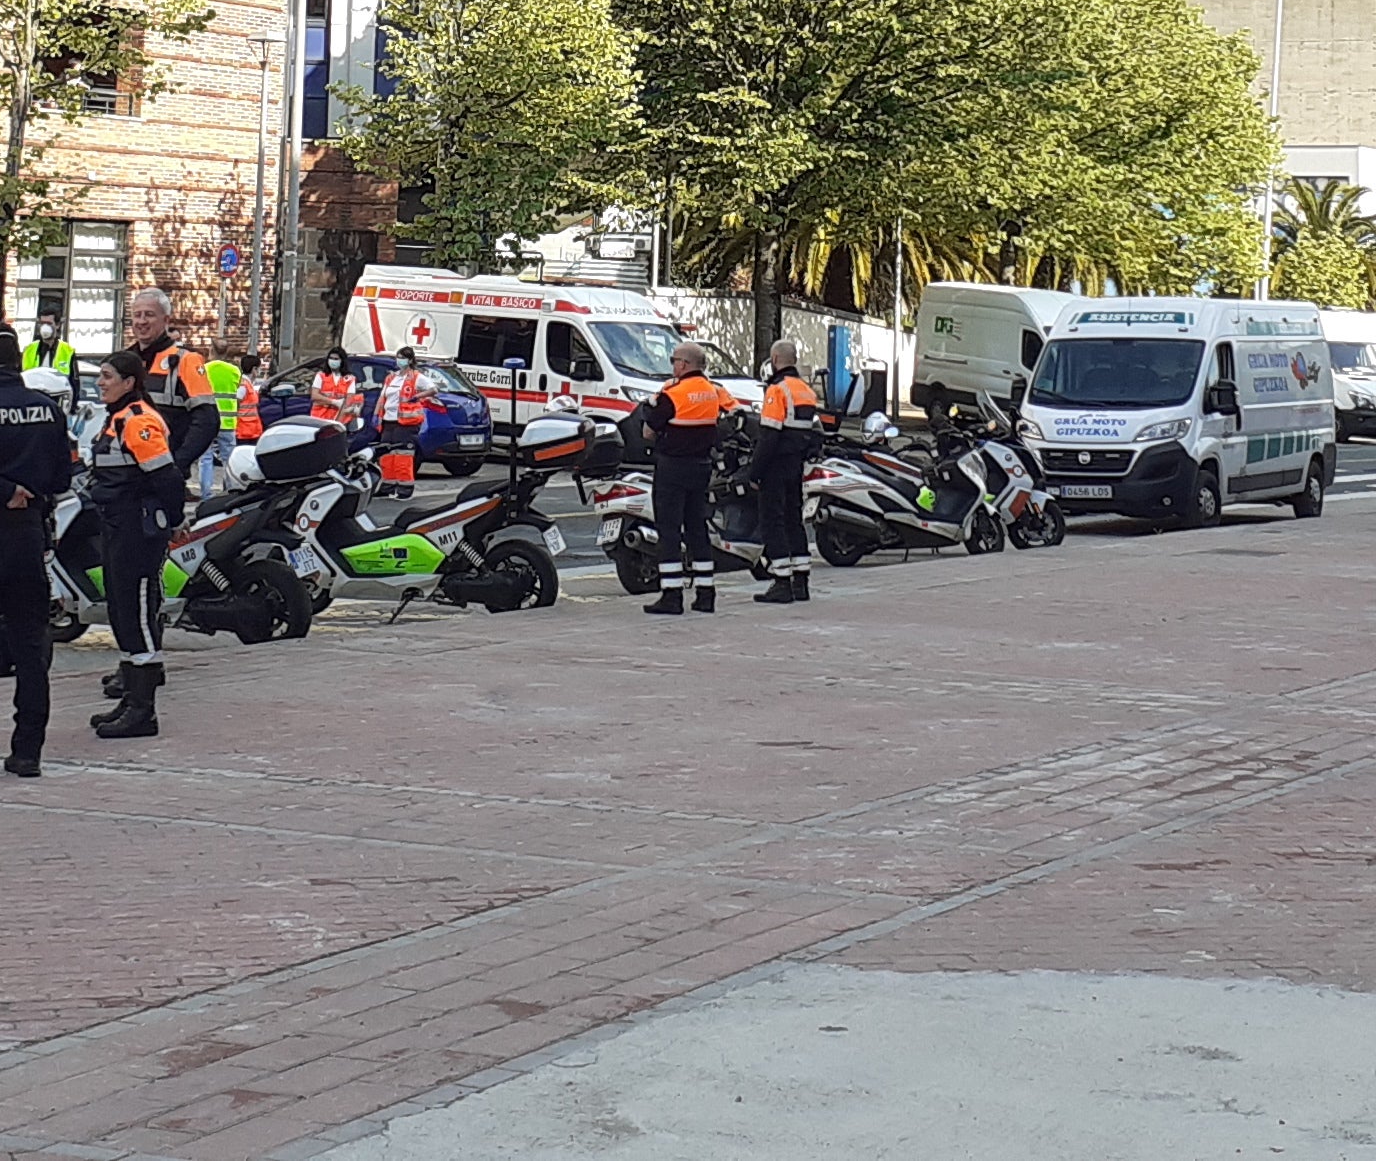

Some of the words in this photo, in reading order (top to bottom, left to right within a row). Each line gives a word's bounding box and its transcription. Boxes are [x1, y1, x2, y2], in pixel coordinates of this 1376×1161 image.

[394, 289, 435, 302] SOPORTE
[1087, 313, 1175, 322] ASISTENCIA
[0, 405, 55, 425] POLIZIA
[1092, 418, 1127, 427] MOTO
[1056, 427, 1120, 437] GIPUZKOA
[438, 531, 459, 546] M11
